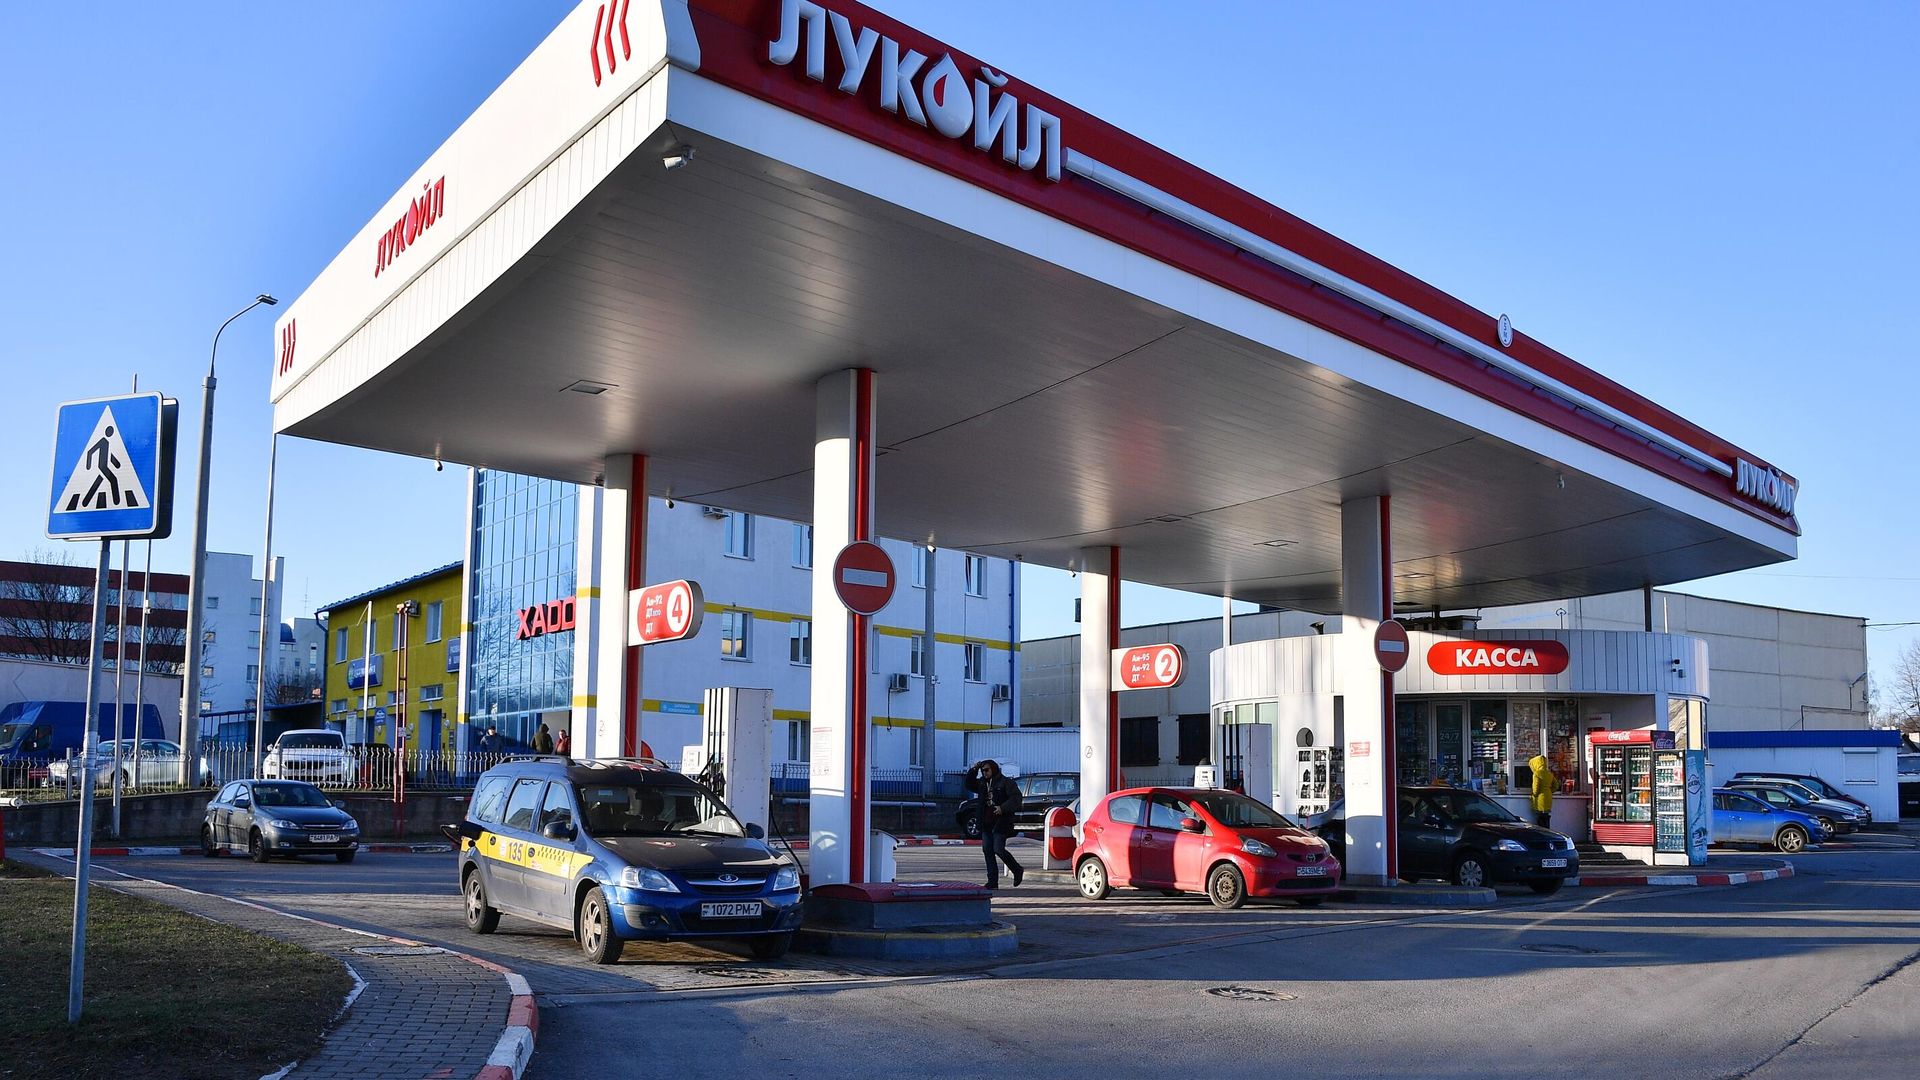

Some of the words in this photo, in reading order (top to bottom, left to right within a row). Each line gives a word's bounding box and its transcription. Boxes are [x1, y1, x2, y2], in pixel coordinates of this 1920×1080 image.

[769, 0, 1060, 183] ЛУКОЙЛ
[375, 175, 445, 278] ЛУКОЙЛ
[1736, 456, 1795, 516] ЛУКОЙЛ
[515, 596, 576, 640] XADO
[672, 595, 683, 624] 4
[646, 622, 653, 635] ДТ
[1161, 653, 1172, 677] 2
[1455, 648, 1539, 668] КАССА
[1131, 674, 1140, 683] ДТ
[509, 842, 523, 861] 135
[712, 904, 733, 915] 1072
[735, 904, 760, 915] PM-7
